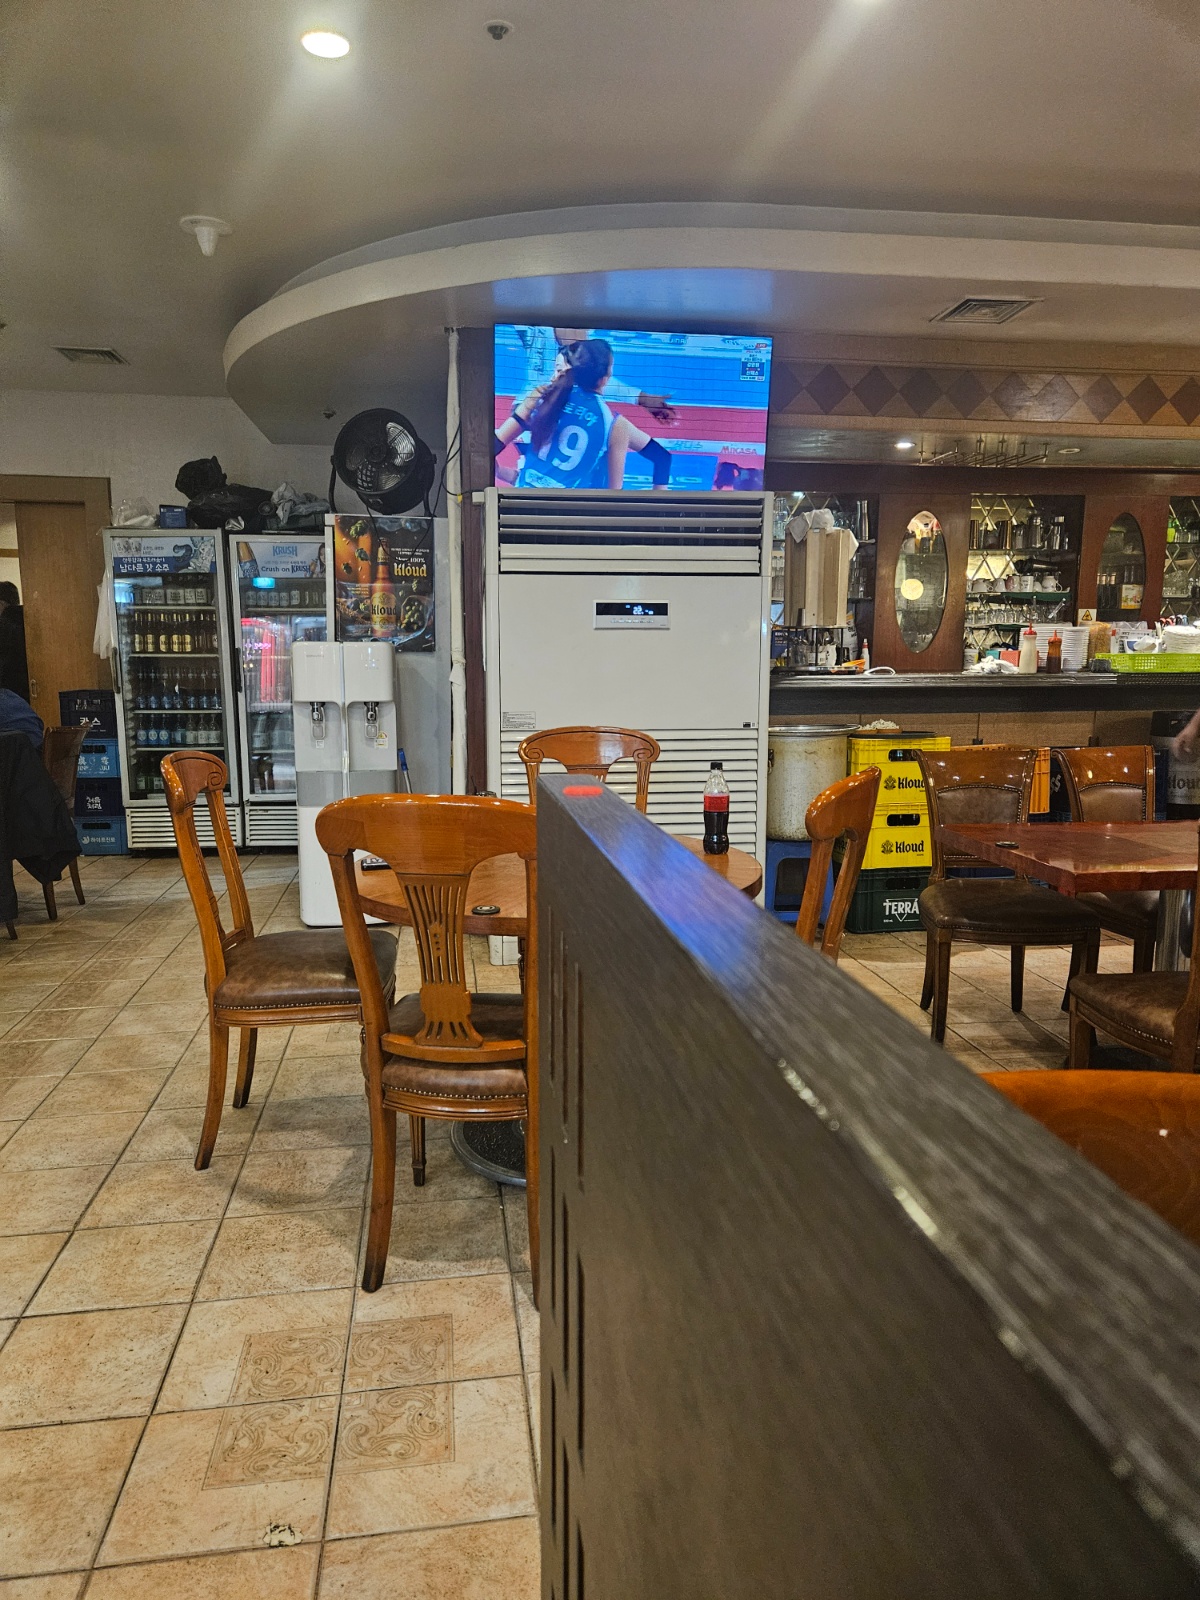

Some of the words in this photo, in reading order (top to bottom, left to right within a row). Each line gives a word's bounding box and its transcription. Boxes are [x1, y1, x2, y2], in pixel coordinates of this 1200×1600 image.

[721, 445, 757, 455] MIKASA
[272, 545, 298, 557] KRUSH
[119, 563, 144, 573] 남다른
[155, 563, 170, 573] 소주
[261, 564, 280, 573] Crush
[291, 564, 311, 574] KRUSH
[393, 562, 427, 577] Kloud
[895, 839, 925, 854] Kloud
[882, 900, 920, 916] TERRA
